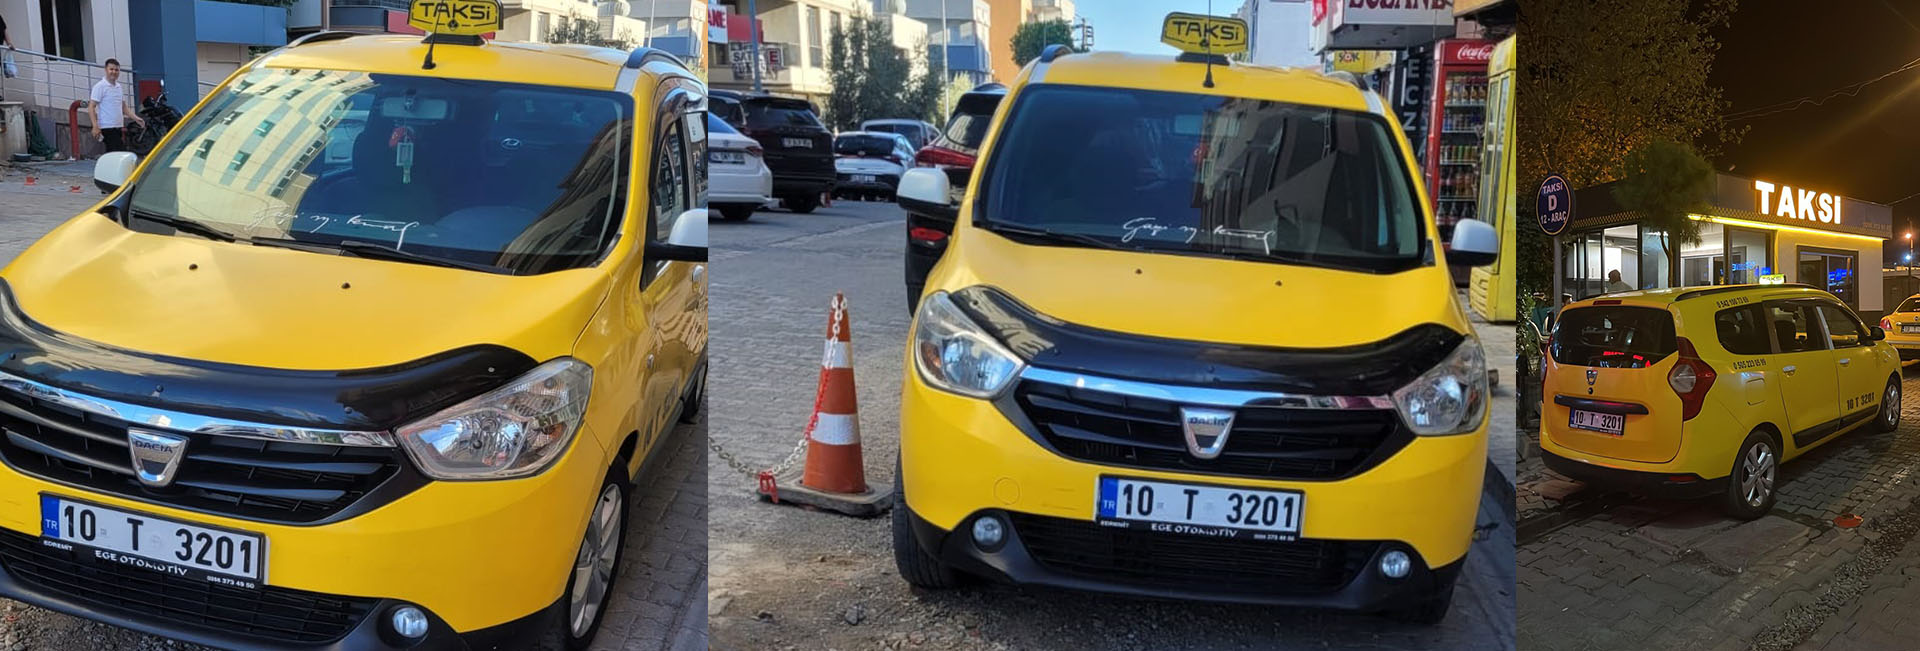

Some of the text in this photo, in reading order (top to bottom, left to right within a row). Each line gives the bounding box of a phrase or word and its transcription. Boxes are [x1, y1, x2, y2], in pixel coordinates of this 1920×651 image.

[1548, 195, 1557, 211] D
[1540, 214, 1547, 224] 12
[1575, 411, 1584, 424] 10
[1590, 413, 1595, 425] T
[1601, 414, 1621, 430] 3201
[135, 440, 173, 453] DACIA
[1103, 483, 1294, 528] TR 10 T 3201
[1151, 523, 1173, 532] EGE
[45, 505, 252, 573] TR 10 T 3201
[95, 550, 118, 561] EGE
[222, 578, 235, 586] 373
